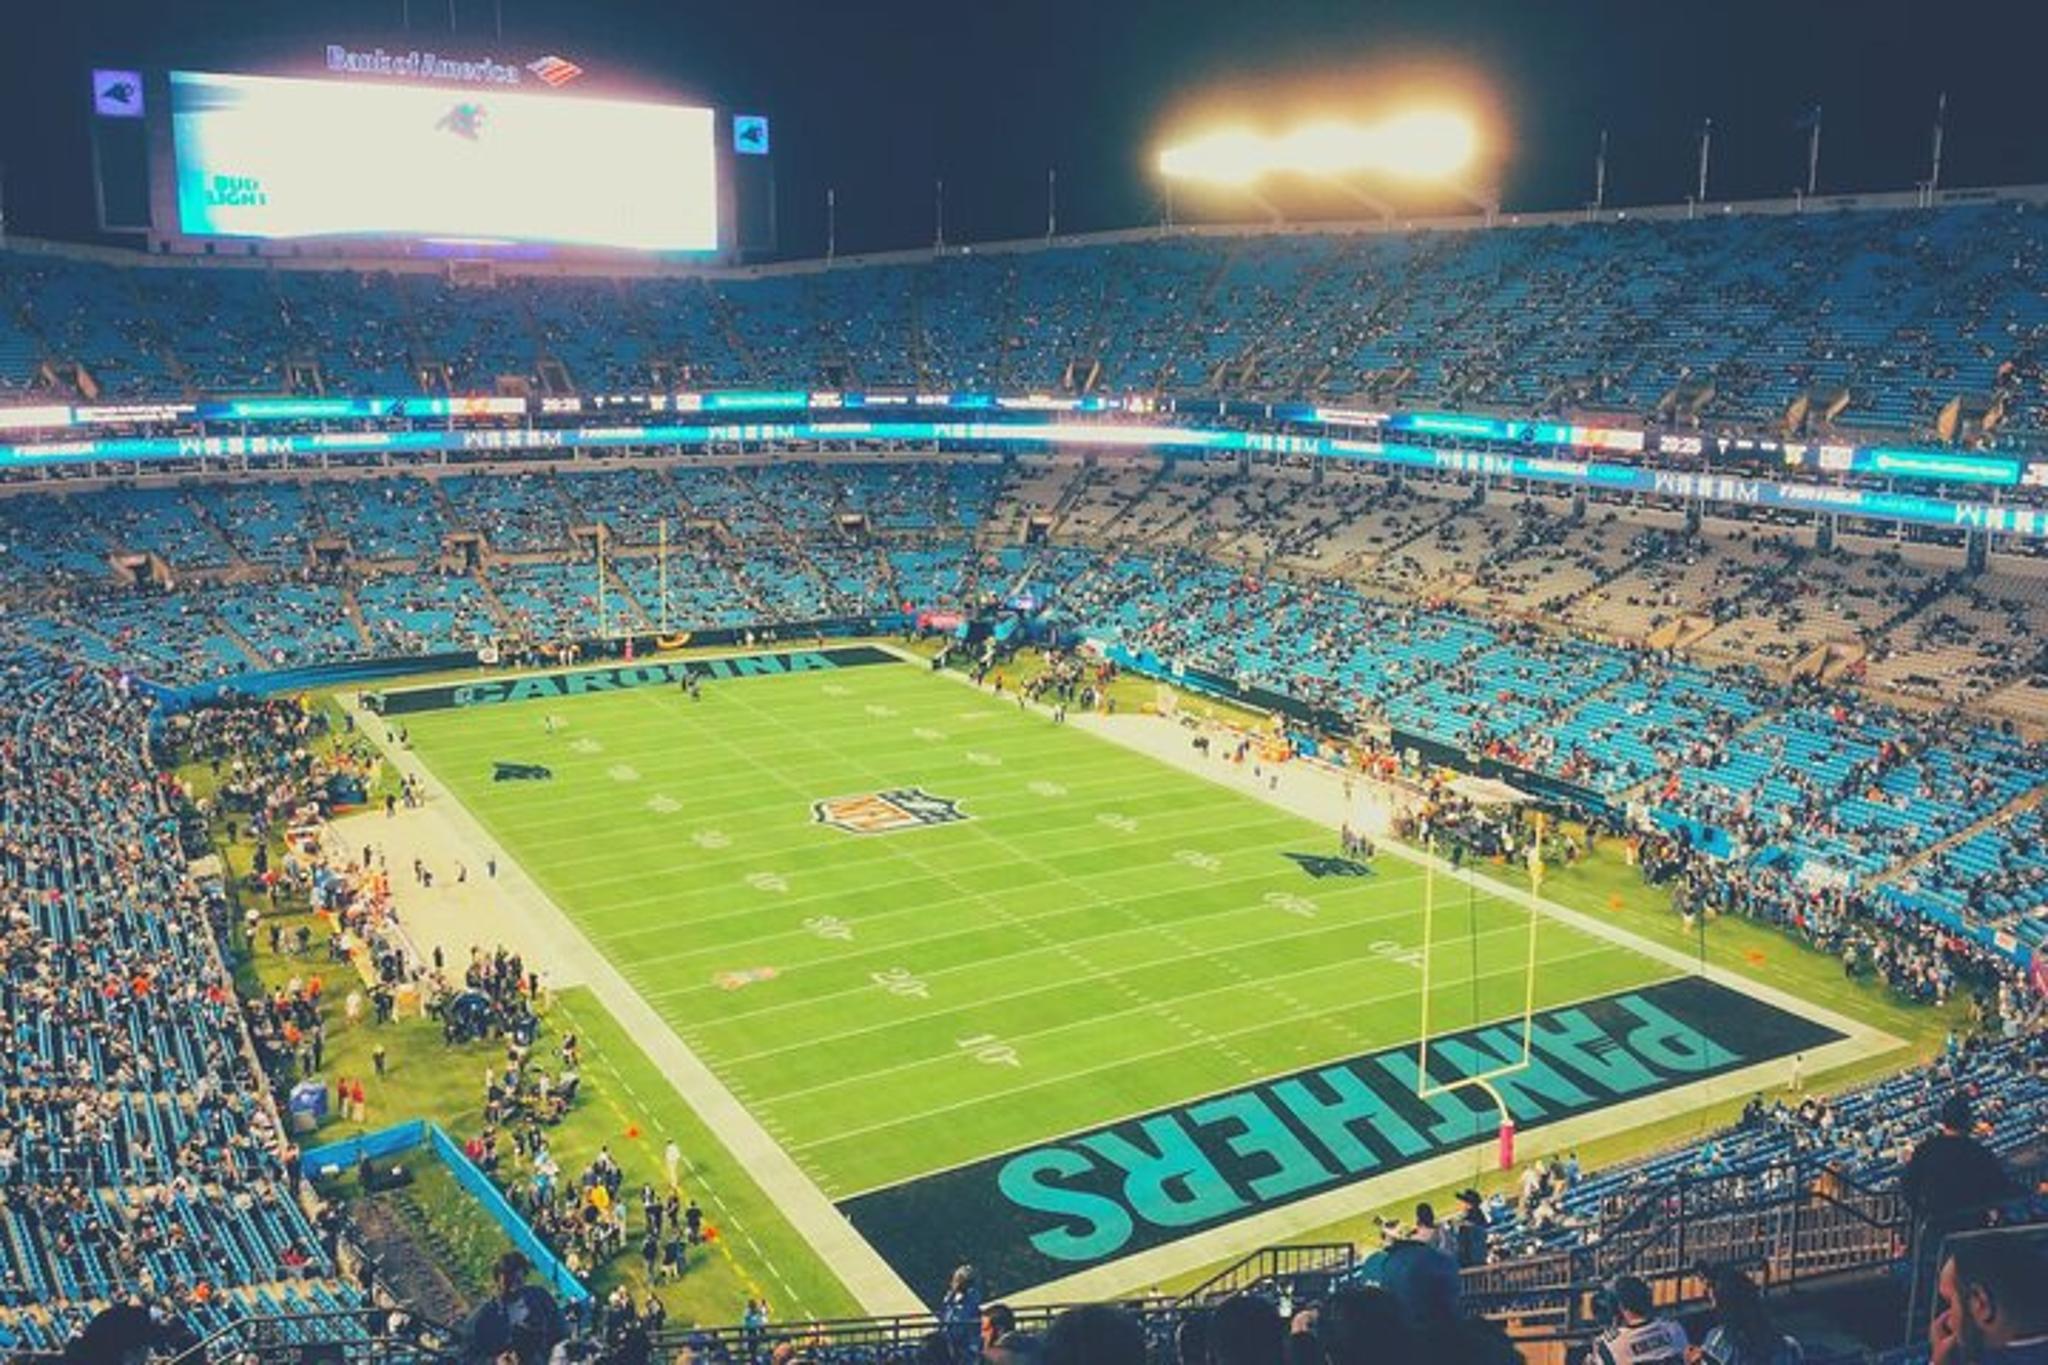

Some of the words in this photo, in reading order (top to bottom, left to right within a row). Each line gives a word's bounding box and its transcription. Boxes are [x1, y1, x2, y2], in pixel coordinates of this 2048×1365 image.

[326, 44, 391, 74] Bank
[392, 51, 419, 75] of
[420, 53, 519, 83] America
[206, 191, 267, 206] LIGHT
[213, 175, 259, 190] BUD
[454, 652, 839, 707] CAROLINA
[997, 995, 1743, 1262] PANTHERS
